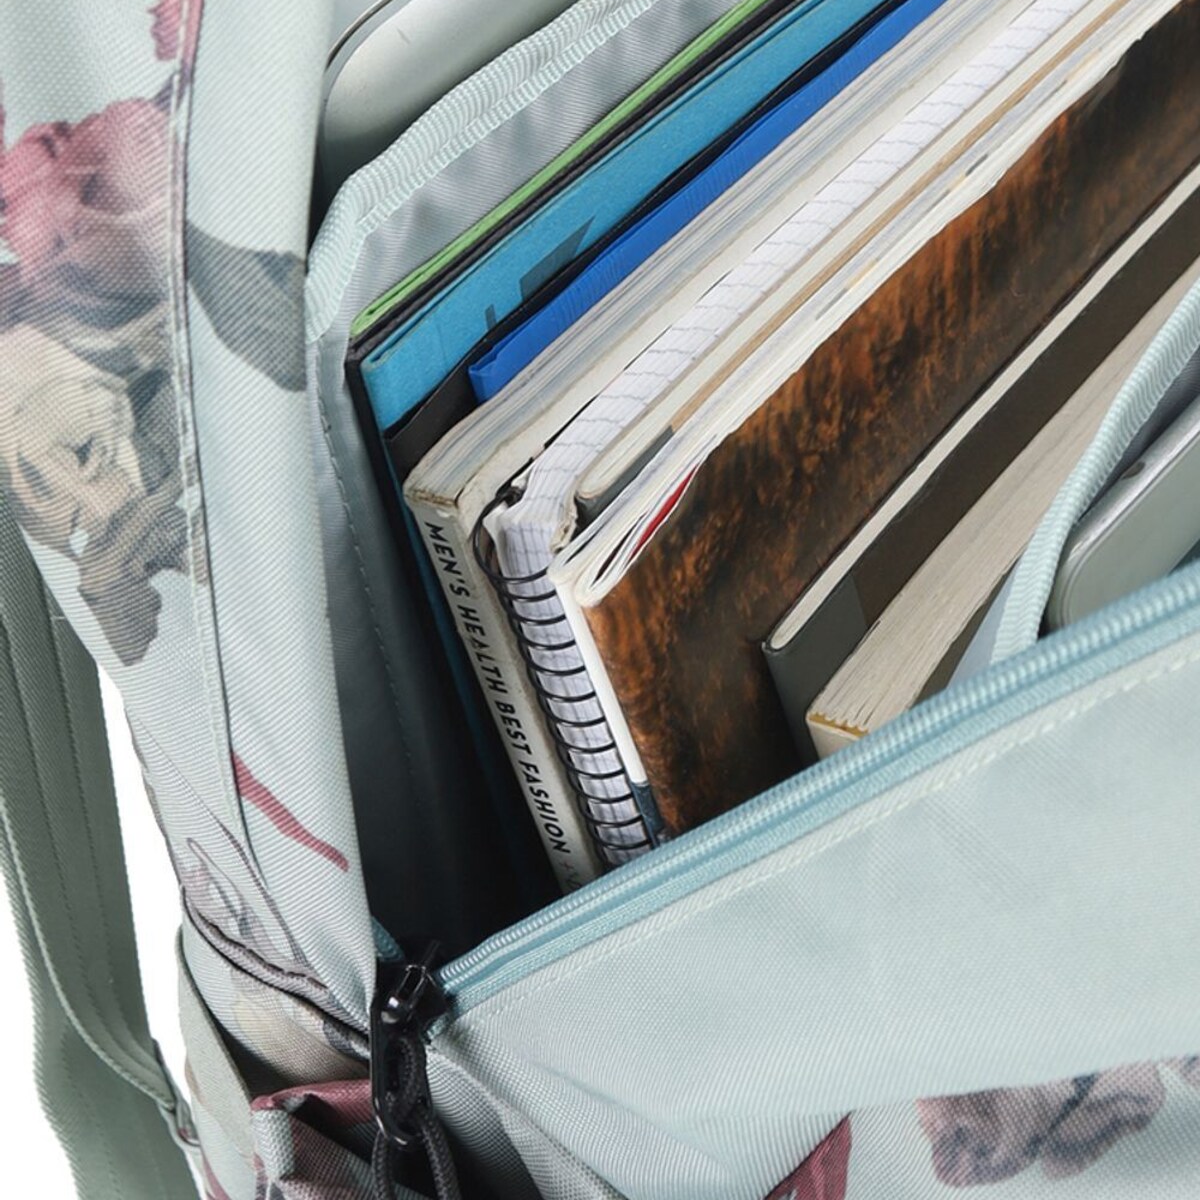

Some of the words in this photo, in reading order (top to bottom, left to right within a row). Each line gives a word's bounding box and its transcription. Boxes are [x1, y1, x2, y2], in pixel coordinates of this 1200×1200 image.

[425, 521, 470, 598] MEN'S
[457, 605, 507, 695] HEALTH
[496, 701, 531, 755] BEST
[518, 759, 571, 855] FASHION
